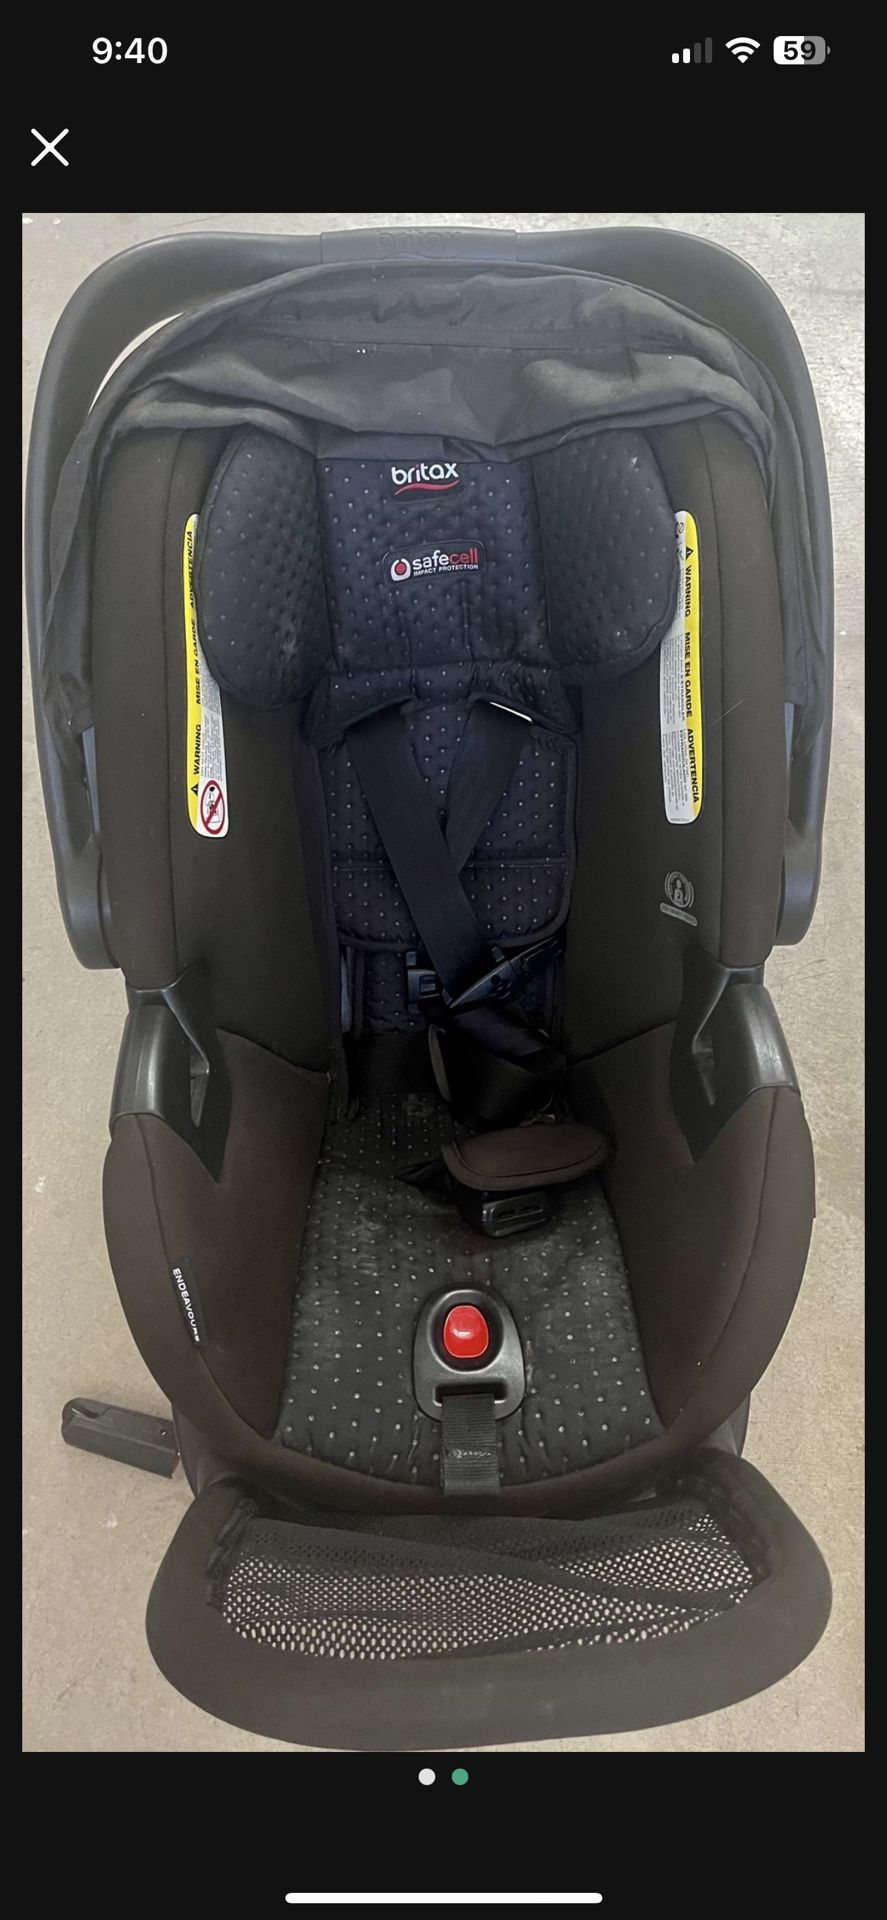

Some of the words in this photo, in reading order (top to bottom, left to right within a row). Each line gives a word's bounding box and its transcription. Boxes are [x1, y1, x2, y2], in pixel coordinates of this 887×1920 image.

[92, 37, 168, 64] 9:40
[784, 40, 816, 60] 59
[391, 463, 459, 485] britax
[412, 547, 479, 571] safecell
[413, 568, 437, 577] IMPACT
[439, 564, 479, 572] PROTECTION
[190, 618, 198, 657] GARDE
[194, 659, 200, 675] EN
[685, 661, 691, 677] EN
[685, 680, 693, 718] GARDE
[193, 723, 201, 775] WARNING
[687, 728, 700, 803] ADVERTENCIA
